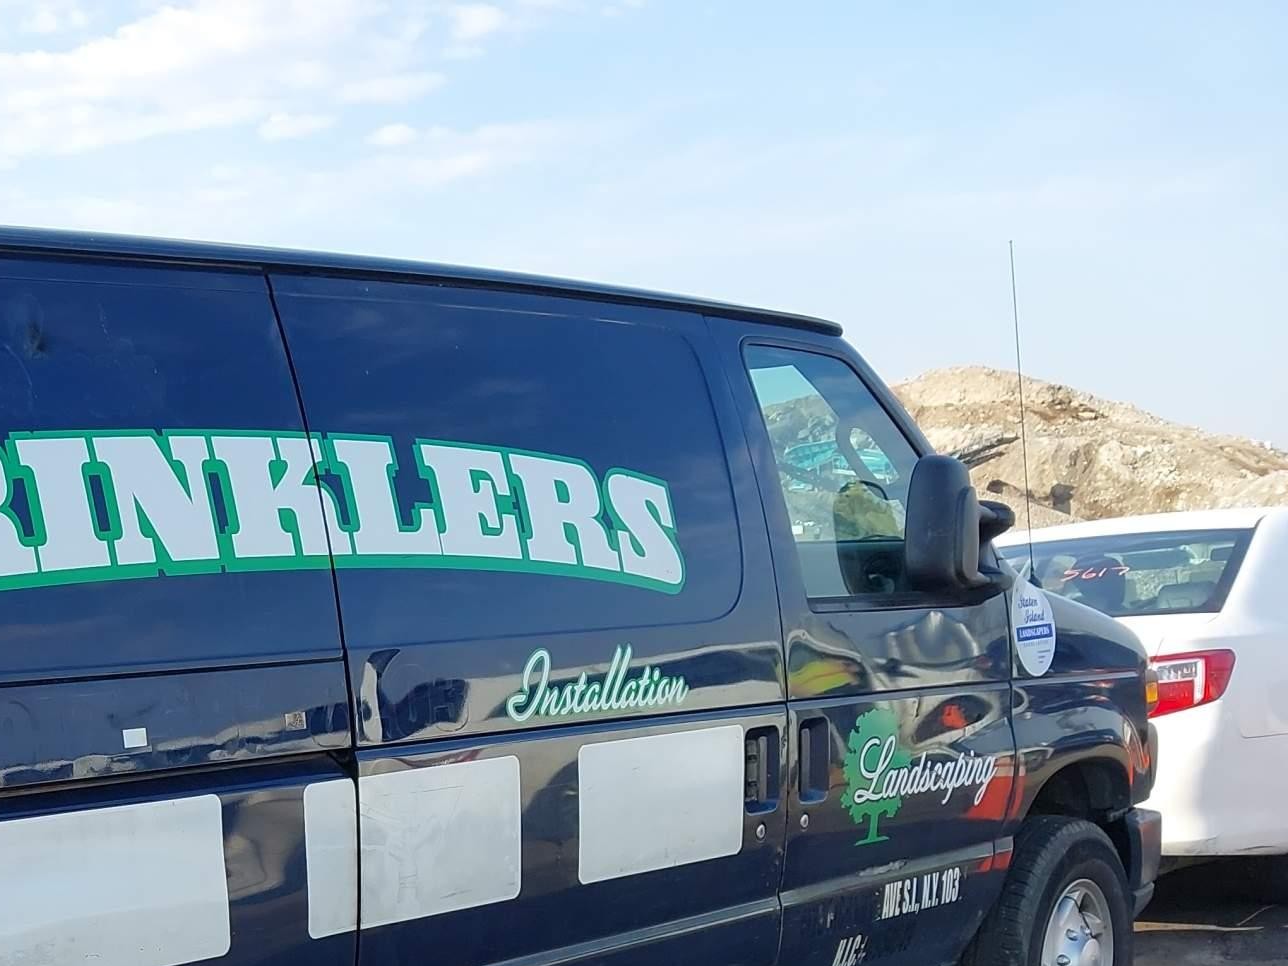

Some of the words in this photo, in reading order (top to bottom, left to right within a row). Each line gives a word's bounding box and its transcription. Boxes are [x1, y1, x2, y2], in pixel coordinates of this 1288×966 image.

[1060, 566, 1130, 582] 5617
[507, 644, 690, 722] Installation
[854, 735, 998, 806] Landscaping
[882, 881, 903, 919] AVE
